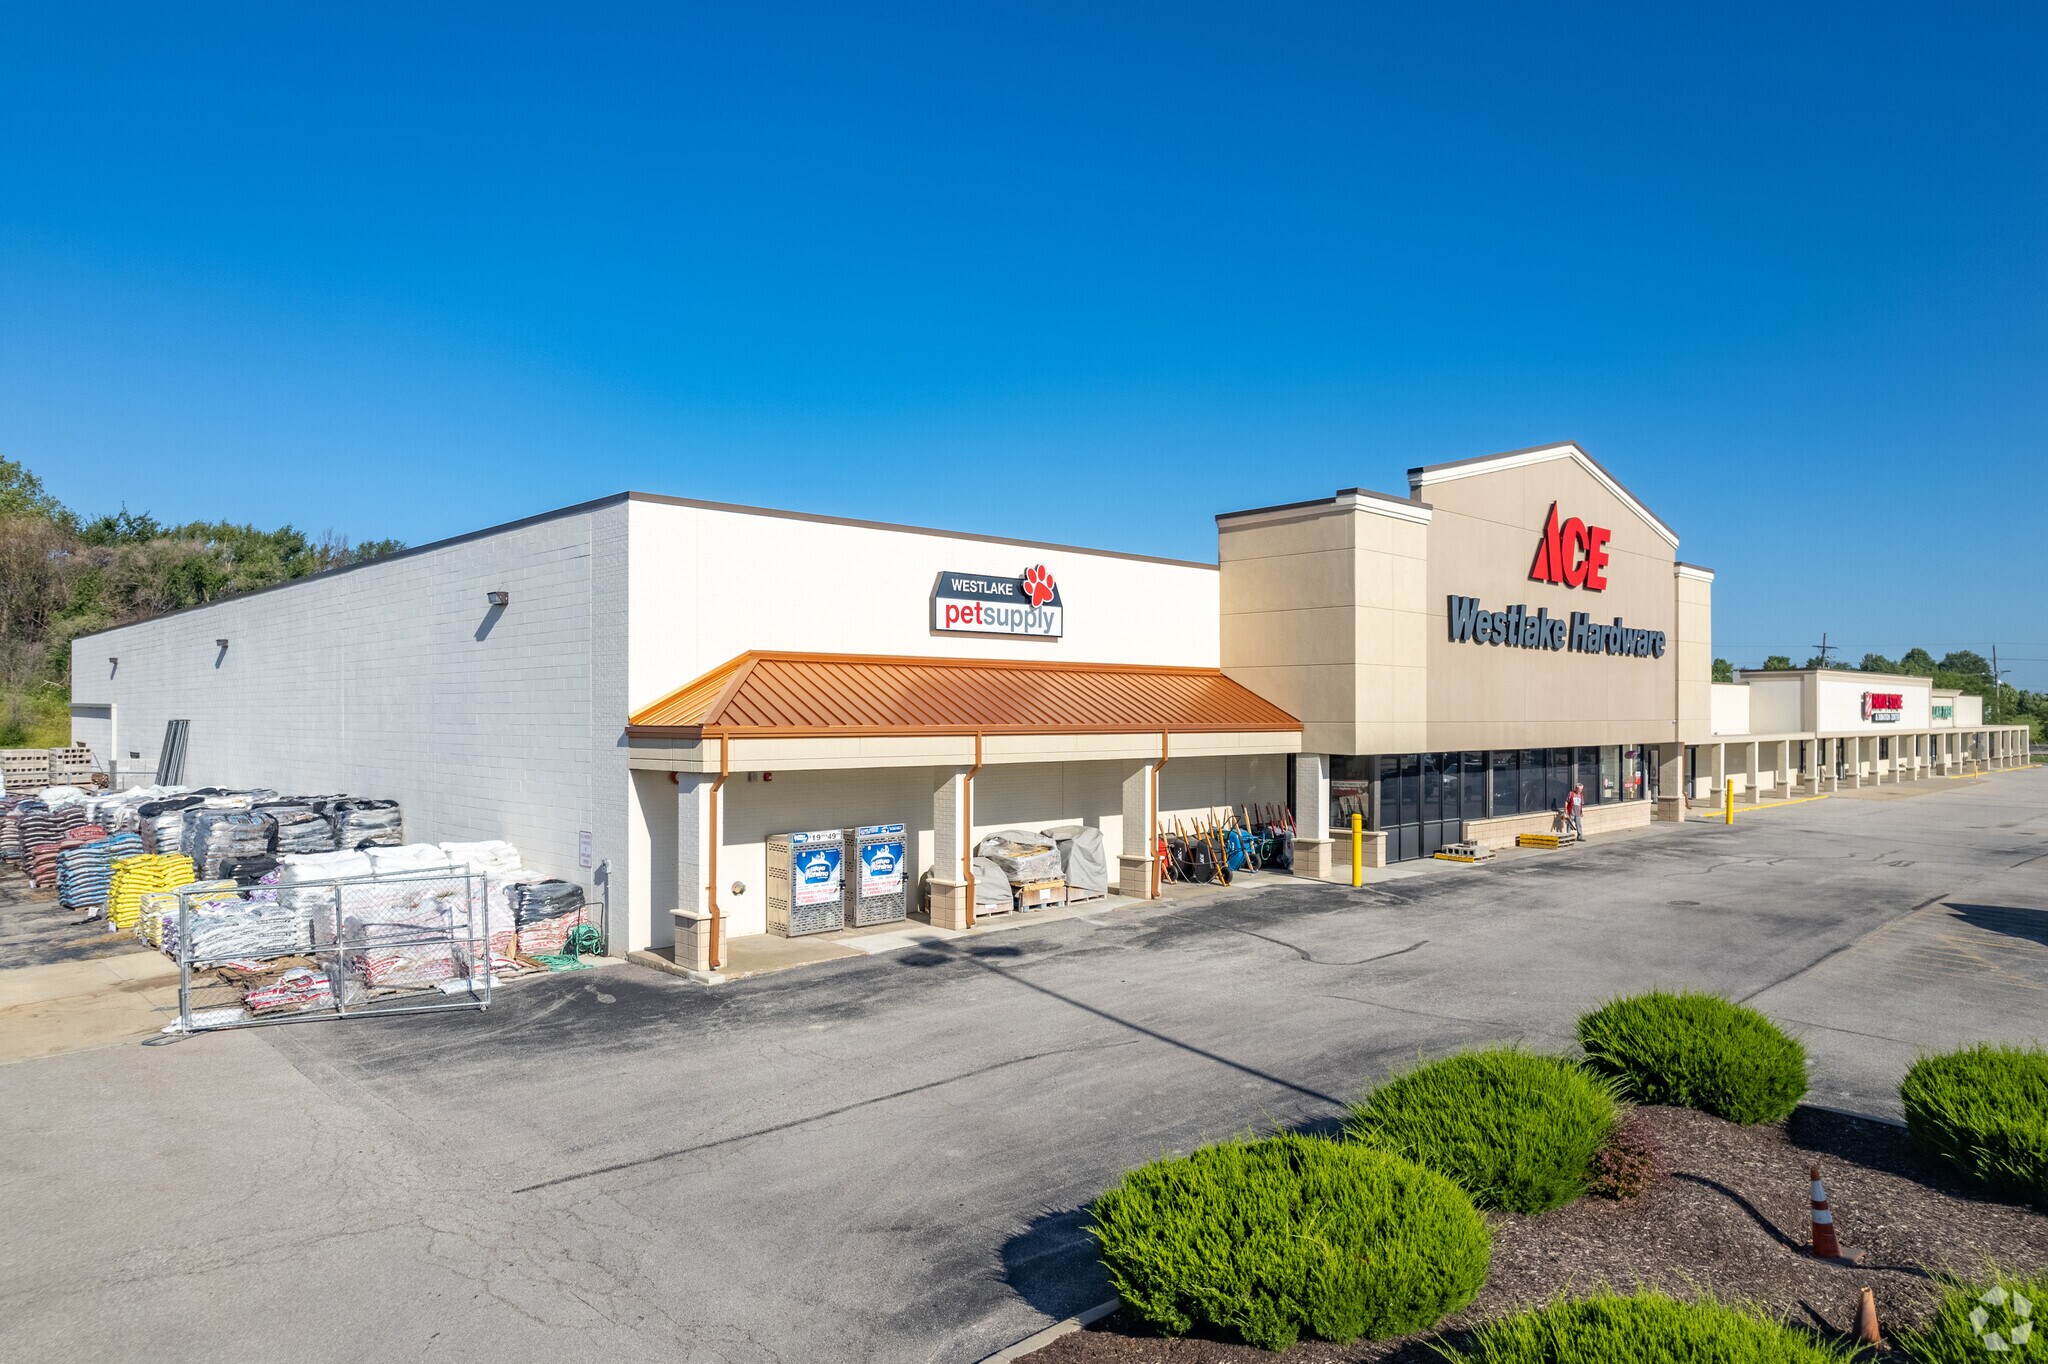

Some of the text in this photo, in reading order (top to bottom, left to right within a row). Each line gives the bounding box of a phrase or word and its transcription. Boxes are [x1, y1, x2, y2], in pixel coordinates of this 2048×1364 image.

[1530, 500, 1611, 591] ACE
[951, 578, 1013, 596] WESTLAKE
[1447, 595, 1666, 658] Westlake Hardware
